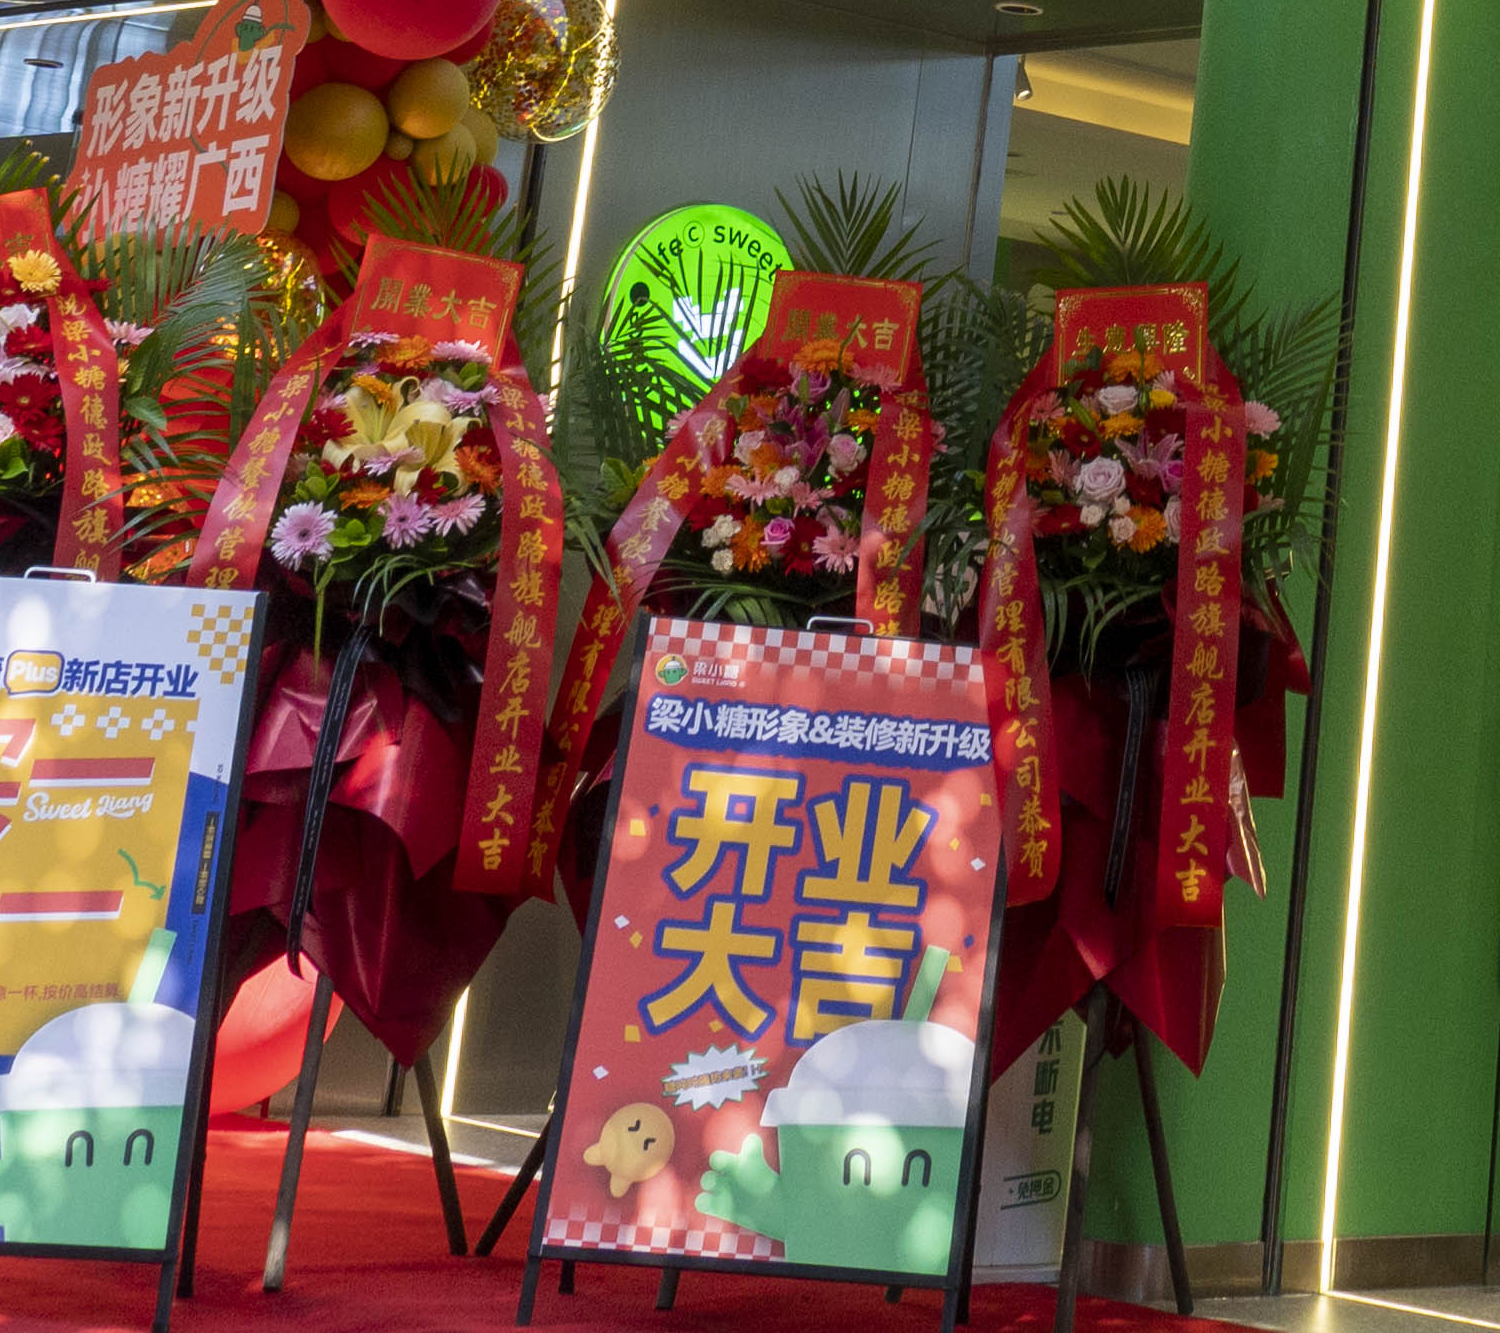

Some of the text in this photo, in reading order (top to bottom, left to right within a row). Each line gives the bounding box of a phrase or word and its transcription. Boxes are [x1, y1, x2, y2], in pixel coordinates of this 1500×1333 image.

[86, 45, 283, 158] 形象新升级
[72, 133, 270, 244] 小糖耀广西
[370, 276, 498, 331] 開業大吉
[477, 375, 555, 872] 梁小糖德政路旗舰店开业大吉
[8, 659, 60, 684] Plus
[61, 658, 200, 699] 新店开业
[693, 661, 741, 681] 梁小糖
[647, 696, 992, 763] 梁小糖形象&装修新升级
[23, 787, 156, 824] Sweet Liang
[667, 769, 934, 909] 开业
[643, 900, 918, 1039] 大吉
